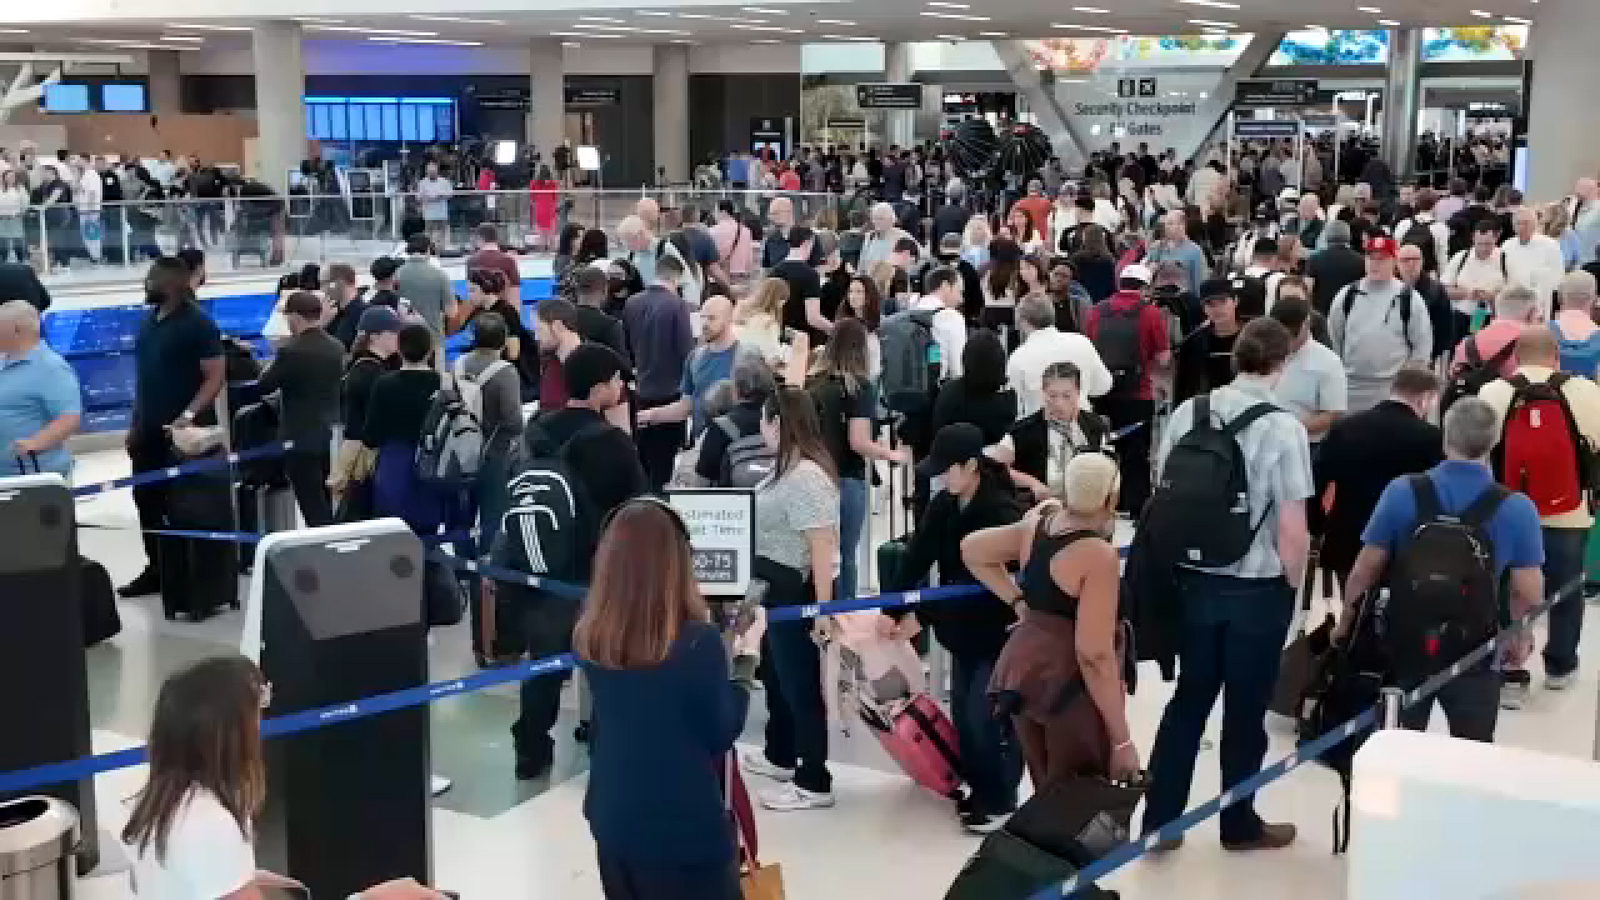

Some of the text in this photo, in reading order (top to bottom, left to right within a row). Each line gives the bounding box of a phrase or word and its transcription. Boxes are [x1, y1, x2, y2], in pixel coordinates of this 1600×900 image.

[1074, 102, 1195, 118] Security Checkpoint
[1127, 122, 1163, 135] Gates
[682, 509, 743, 521] stimated
